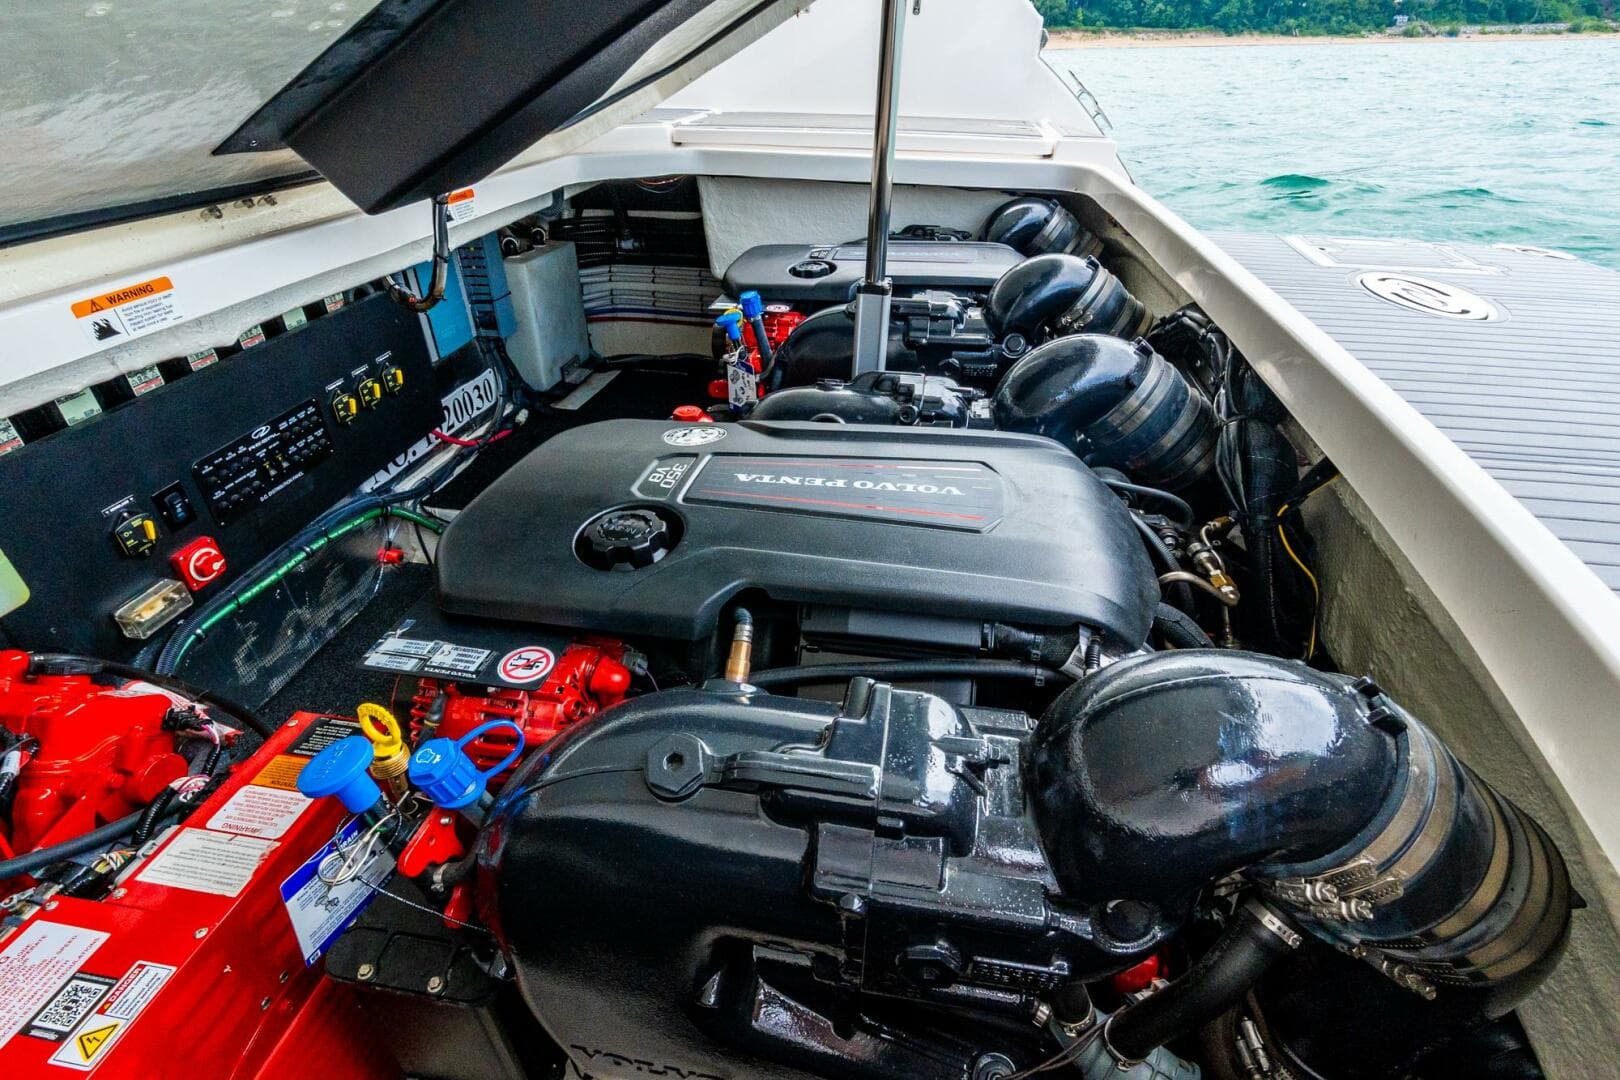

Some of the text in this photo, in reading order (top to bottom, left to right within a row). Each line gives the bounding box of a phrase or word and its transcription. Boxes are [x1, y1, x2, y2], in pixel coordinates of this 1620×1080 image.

[106, 284, 154, 305] WARNING
[647, 465, 671, 483] V8
[659, 463, 687, 489] 350
[731, 472, 963, 496] VOLVO PENTA
[449, 670, 478, 678] VOLVO
[220, 823, 258, 833] WARNING
[107, 967, 143, 1002] DANGER
